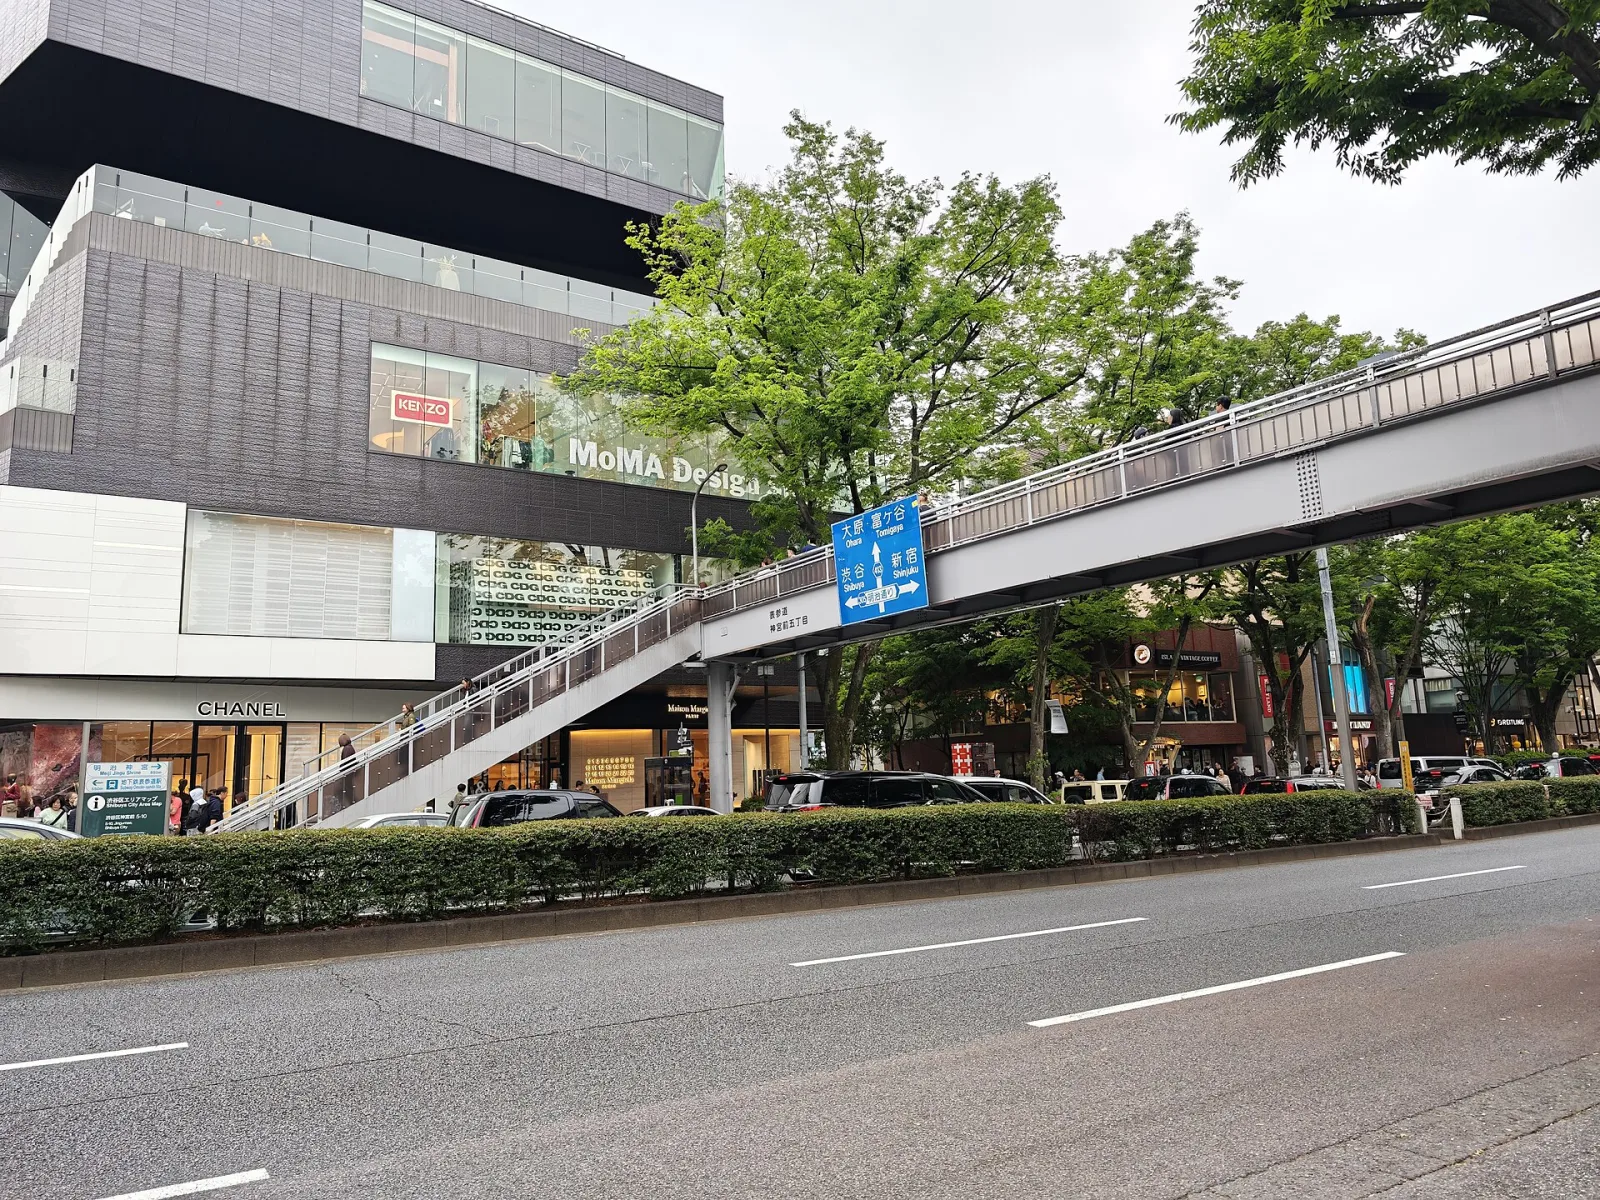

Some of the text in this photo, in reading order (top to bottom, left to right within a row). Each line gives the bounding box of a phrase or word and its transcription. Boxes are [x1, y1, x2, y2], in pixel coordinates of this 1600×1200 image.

[398, 398, 446, 416] KENZO
[569, 438, 665, 479] MoMA
[673, 457, 760, 496] Design
[842, 518, 864, 540] 大原
[846, 523, 904, 548] Ohara Tomigaya
[476, 560, 652, 579] CDG CDG CDG CDG CDG CDG
[841, 547, 918, 584] 渋谷 新宿
[478, 580, 508, 589] CDG
[510, 582, 539, 591] CDG
[542, 585, 570, 593] CDG
[572, 587, 599, 595] CDG
[602, 589, 628, 597] CDG
[493, 571, 522, 579] CDG
[525, 573, 553, 582] CDG
[556, 576, 583, 584] CDG
[586, 578, 612, 586] CDG
[615, 580, 640, 588] CDG
[844, 566, 919, 593] Shibuya Shinjuku
[496, 592, 524, 600] CDG
[528, 595, 556, 603] CDG
[559, 596, 586, 605] CDG
[589, 598, 615, 606] CDG
[770, 616, 808, 633] 神宮前五丁目
[198, 702, 286, 717] CHANEL
[668, 704, 689, 712] Maison
